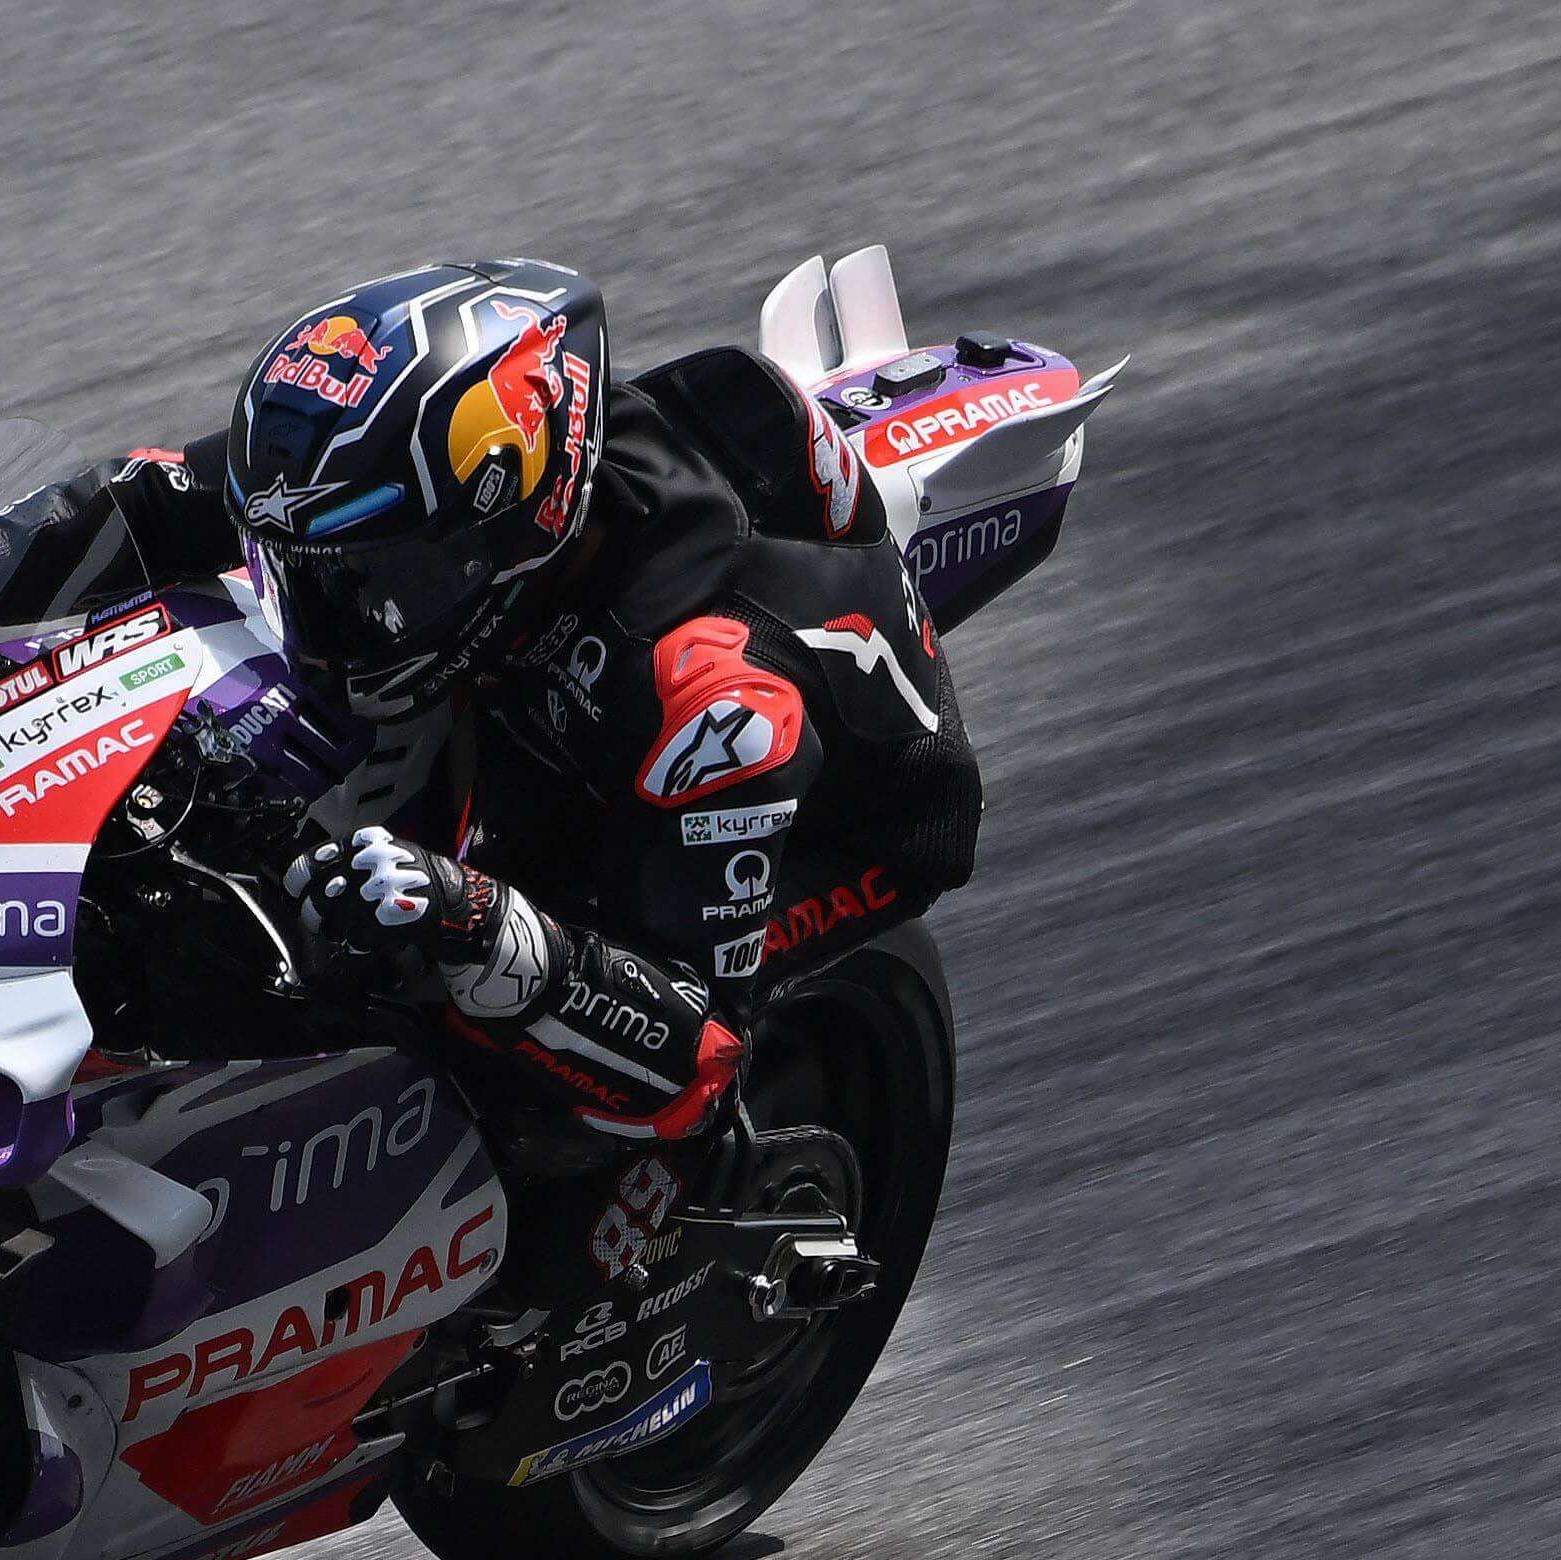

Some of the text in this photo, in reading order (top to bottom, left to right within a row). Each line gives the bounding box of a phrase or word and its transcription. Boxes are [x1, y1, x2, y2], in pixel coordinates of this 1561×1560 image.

[297, 358, 374, 408] Bull
[911, 383, 1053, 443] PRAMAC
[909, 509, 1022, 590] prima
[58, 611, 160, 678] WRS
[129, 658, 173, 686] SPORT
[229, 682, 297, 746] DUCATI
[717, 810, 793, 835] kyrrex
[722, 935, 765, 974] 100
[560, 981, 670, 1050] prima
[124, 1204, 494, 1423] PRAMAC
[560, 1321, 627, 1361] RCB
[575, 1381, 697, 1459] MICHELIN
